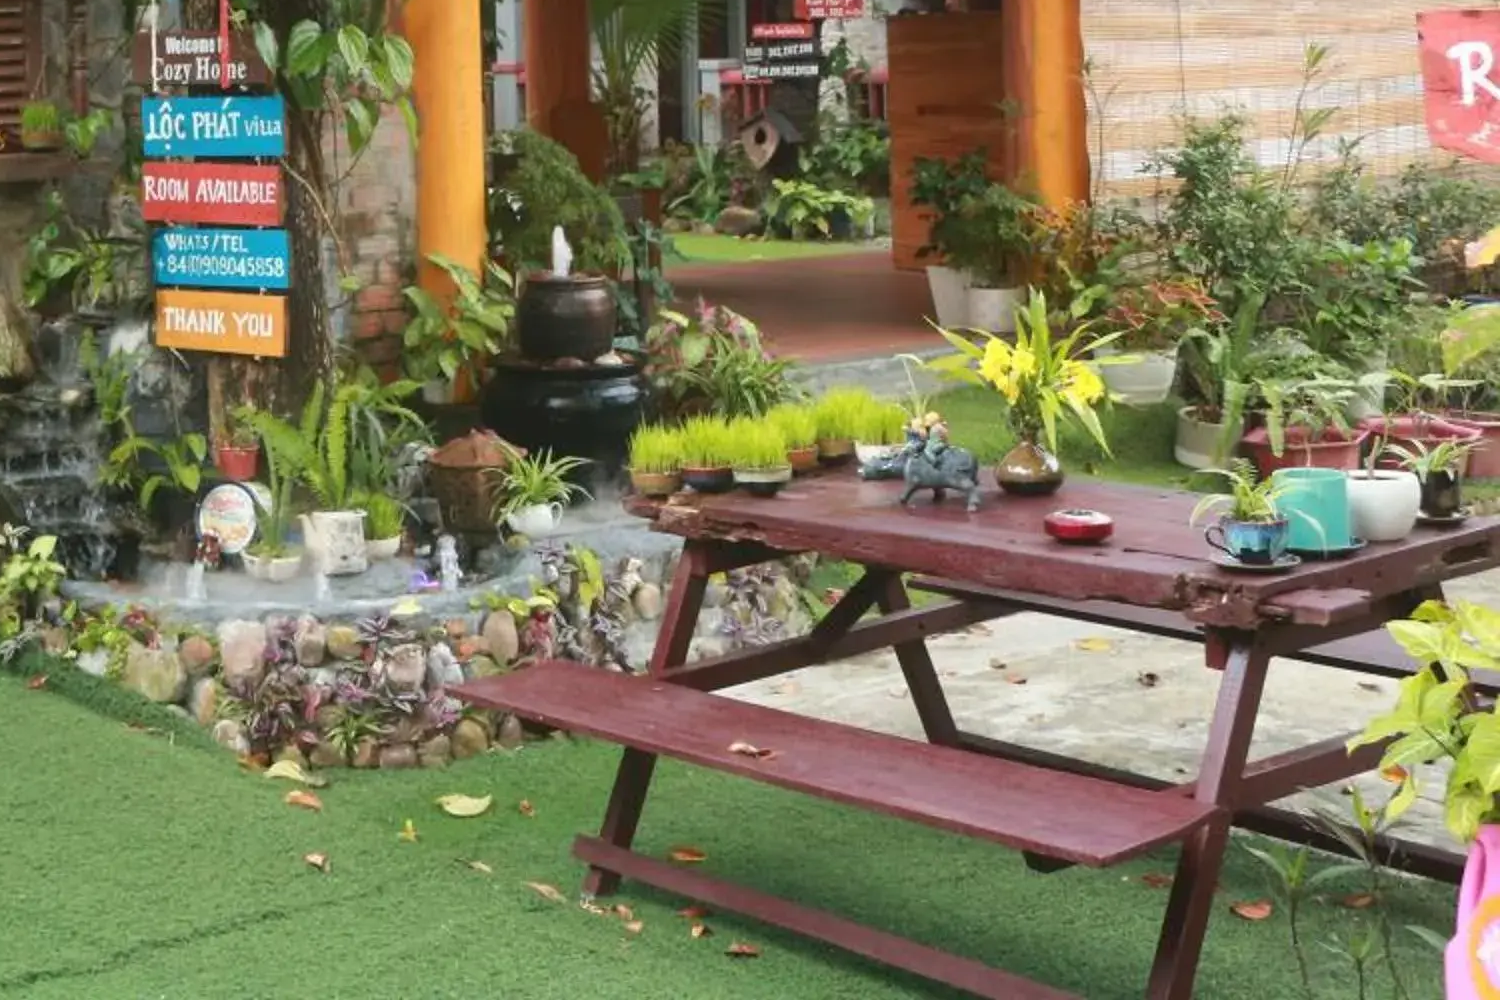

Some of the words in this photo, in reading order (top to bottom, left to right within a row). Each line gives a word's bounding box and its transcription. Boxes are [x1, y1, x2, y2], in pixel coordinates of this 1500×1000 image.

[165, 36, 216, 54] Welcome
[152, 56, 192, 85] Cozy
[145, 101, 186, 150] LỘC
[192, 97, 241, 140] PHÁT
[143, 175, 189, 204] ROOM
[195, 178, 277, 205] AVAILABLE
[162, 306, 226, 335] THANK
[231, 311, 273, 338] YOU
